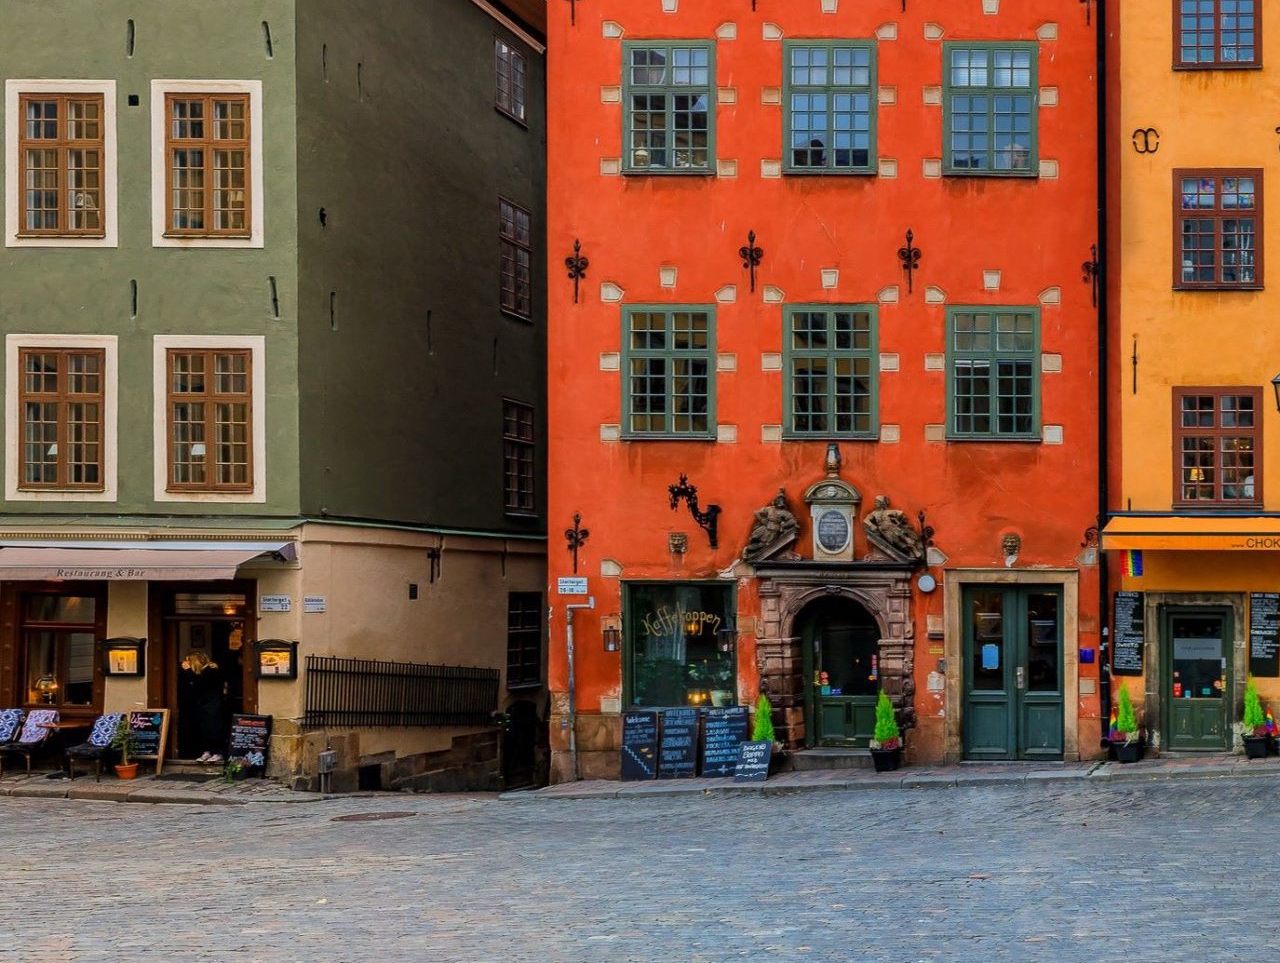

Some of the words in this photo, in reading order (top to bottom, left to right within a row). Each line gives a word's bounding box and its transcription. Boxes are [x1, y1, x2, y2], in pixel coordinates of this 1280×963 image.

[56, 568, 113, 578] Restaurang
[115, 568, 124, 577] &
[127, 568, 146, 577] Bar
[641, 601, 721, 636] Kaffekoppen
